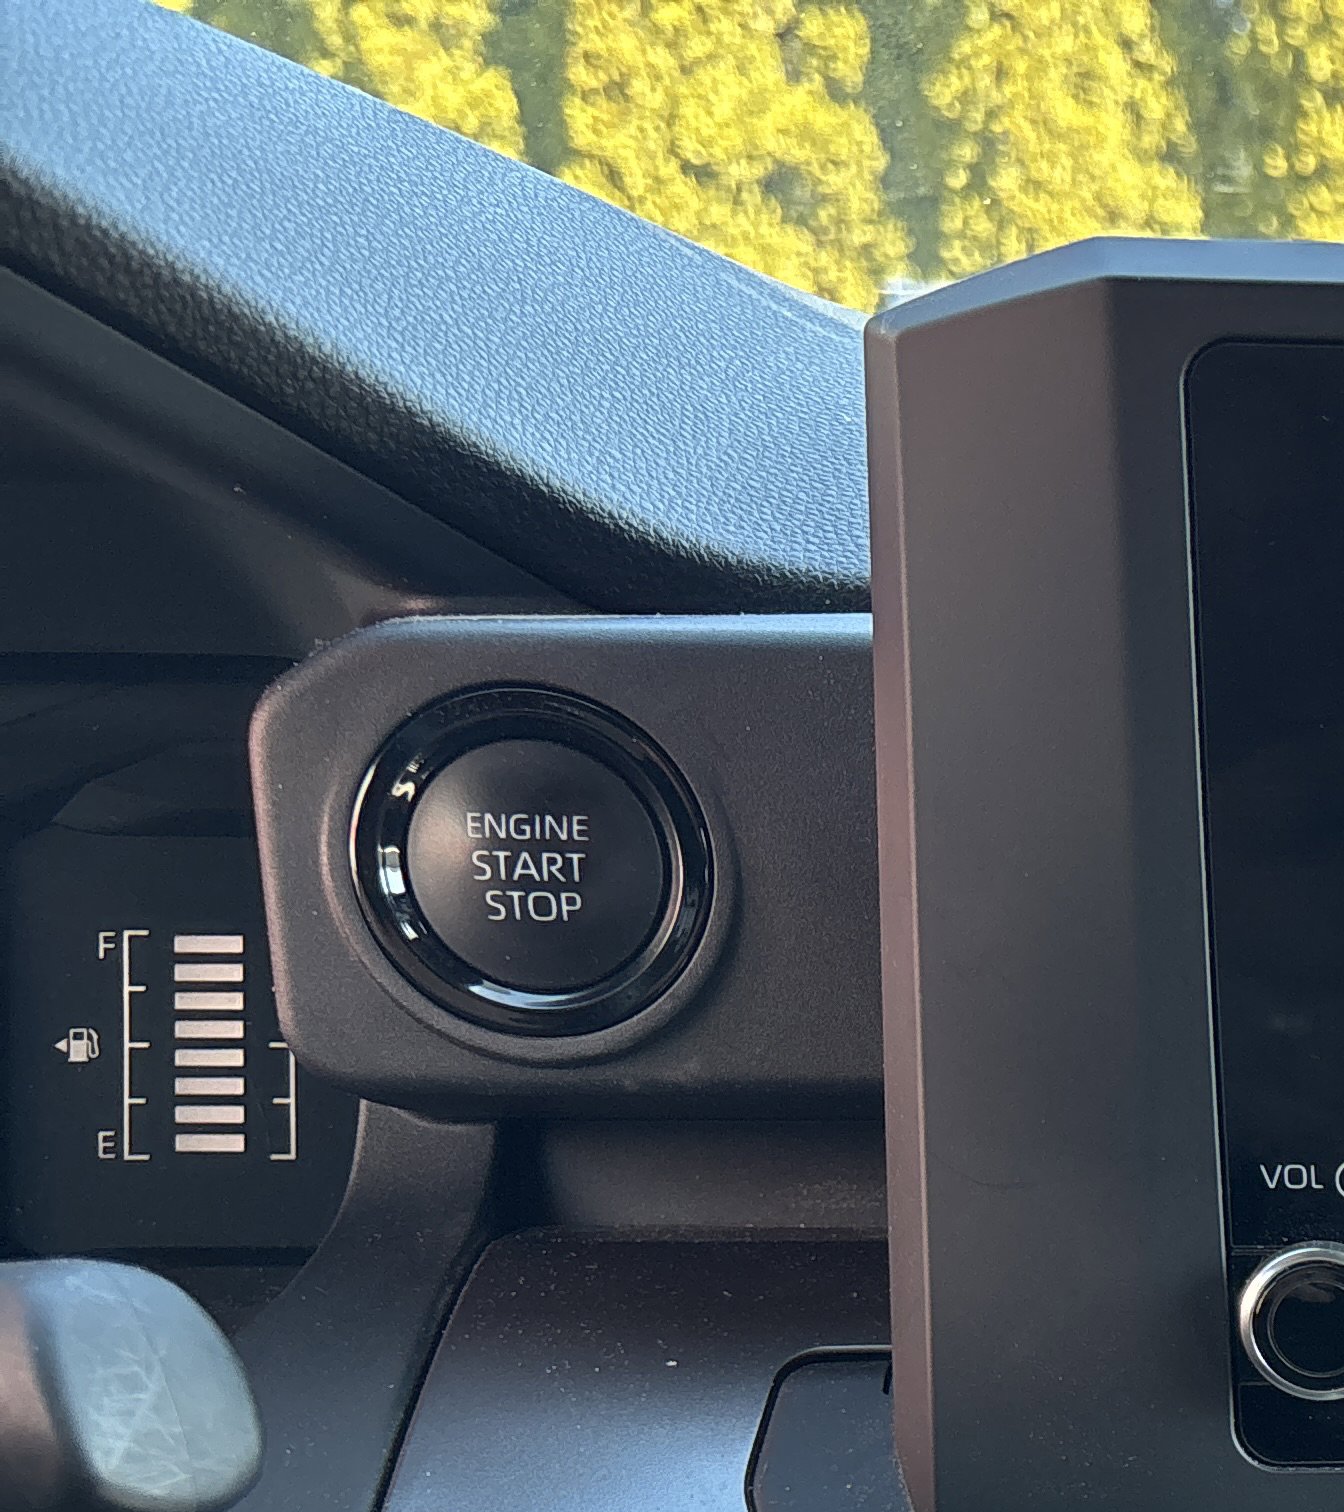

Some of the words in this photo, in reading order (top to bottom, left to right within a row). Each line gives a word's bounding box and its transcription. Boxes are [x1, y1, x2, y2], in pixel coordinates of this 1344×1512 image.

[466, 812, 589, 841] ENGINE
[471, 850, 586, 882] START
[485, 890, 582, 922] STOP
[97, 932, 117, 960] F
[97, 1131, 116, 1159] E
[1259, 1164, 1324, 1190] VOL
